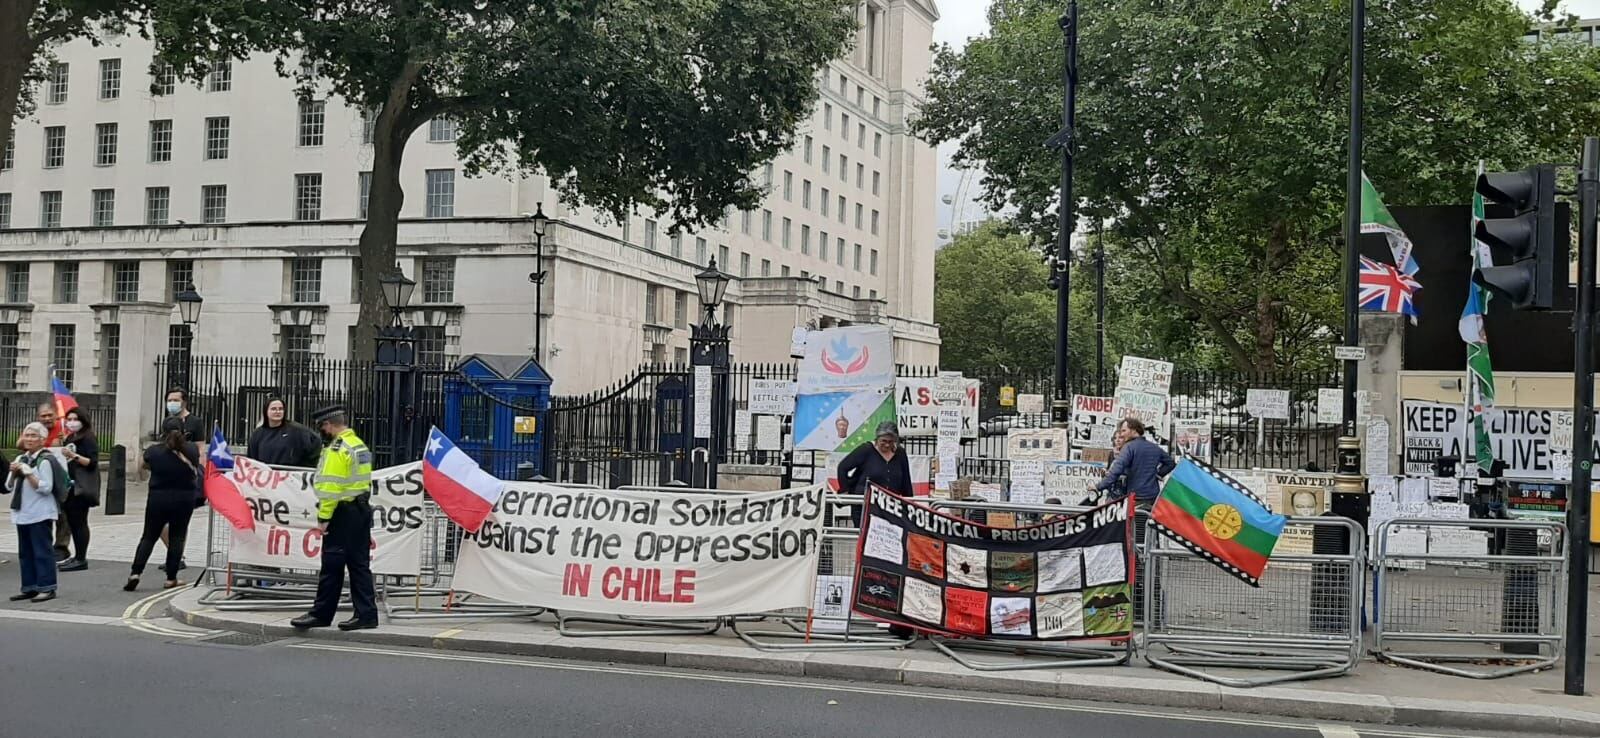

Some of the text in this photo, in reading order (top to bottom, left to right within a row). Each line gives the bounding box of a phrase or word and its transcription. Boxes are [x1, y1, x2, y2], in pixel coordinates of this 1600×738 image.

[1126, 360, 1168, 373] THE PCR
[1124, 368, 1150, 379] TESTS
[1131, 378, 1157, 388] WORK
[900, 415, 970, 430] NETWK
[1406, 406, 1457, 433] KEEP
[1408, 438, 1441, 447] BLACK &
[1410, 449, 1440, 460] WHITE
[1046, 464, 1064, 476] WE
[1276, 475, 1337, 487] WANTED
[669, 488, 824, 527] Solidarity
[870, 484, 1128, 541] FREE POLITICAL PRISONERS NOW
[570, 526, 622, 560] the
[634, 526, 818, 563] Oppression
[562, 563, 697, 604] IN CHILE
